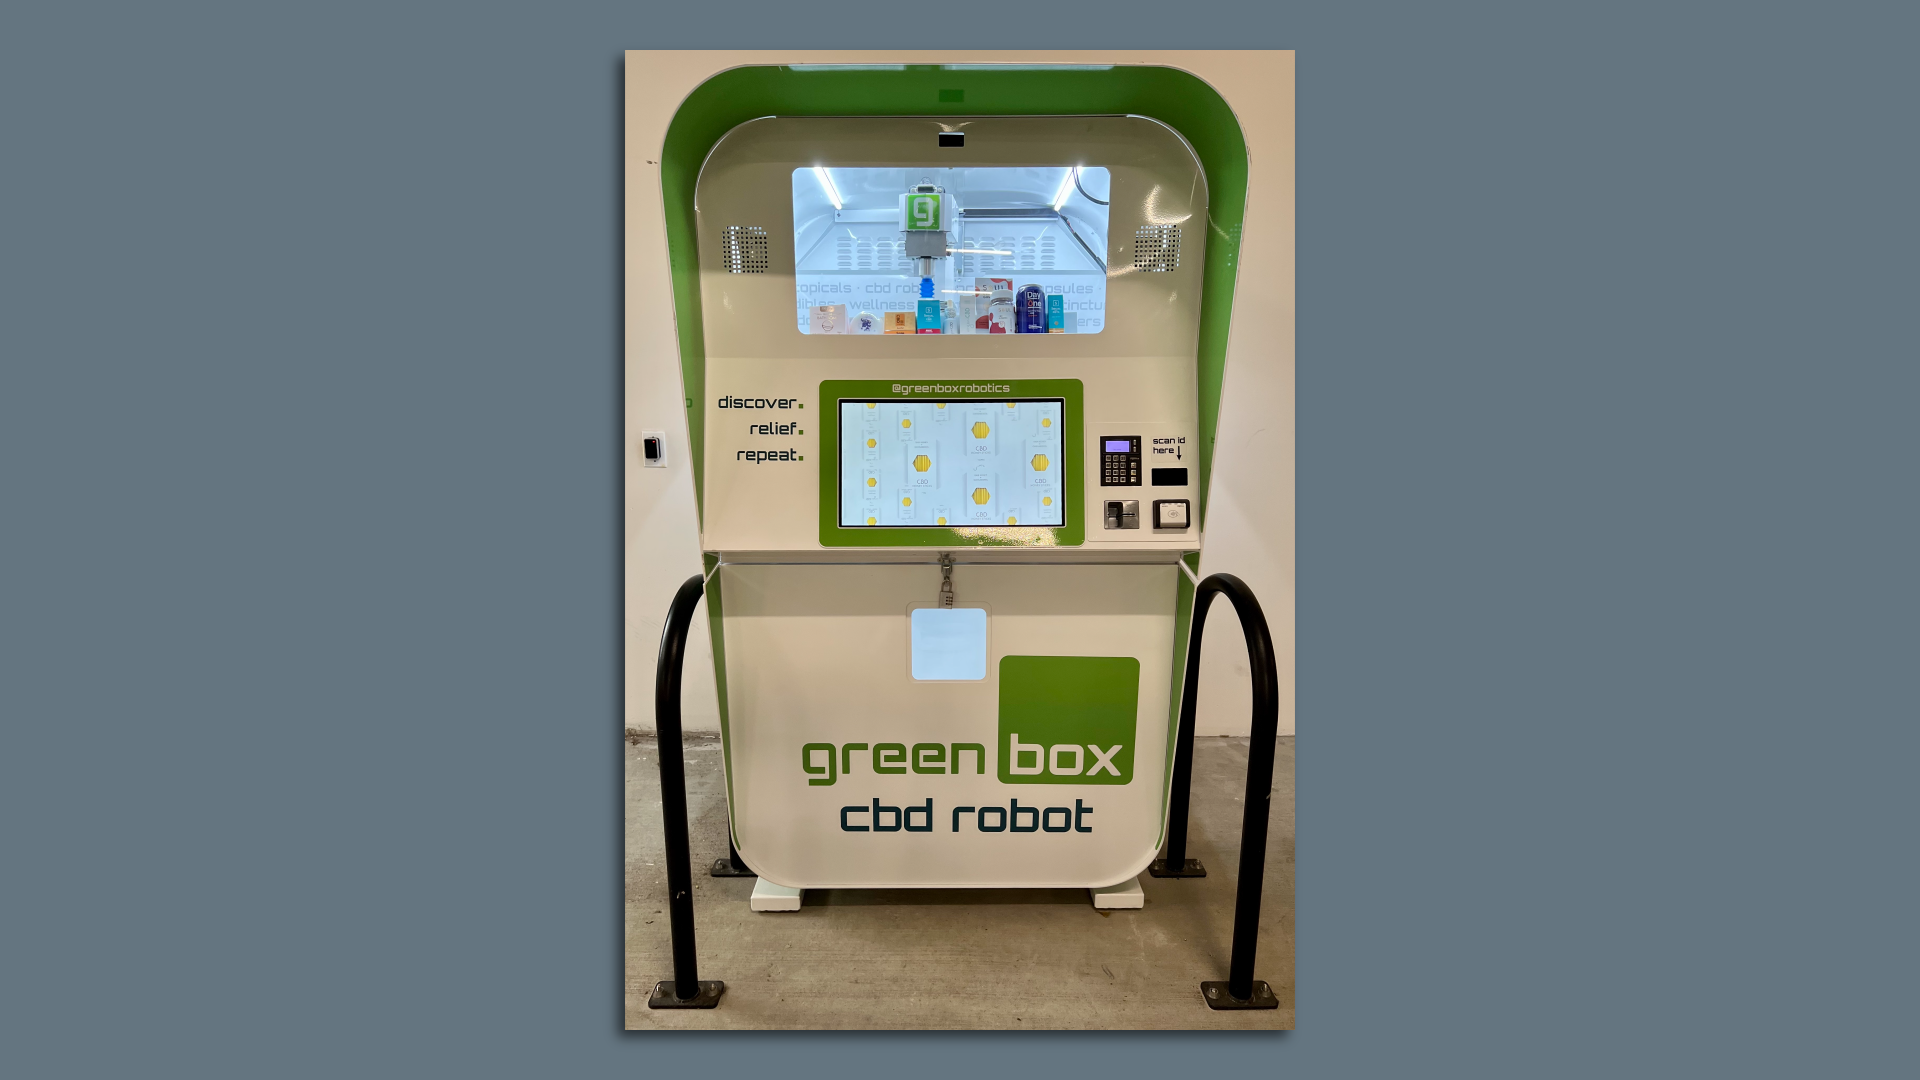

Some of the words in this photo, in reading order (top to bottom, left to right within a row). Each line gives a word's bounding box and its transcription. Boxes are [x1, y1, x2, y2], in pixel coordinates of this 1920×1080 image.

[865, 282, 892, 294] cbd
[895, 282, 920, 294] rob
[1042, 282, 1094, 295] psules
[1027, 291, 1040, 299] Day
[797, 298, 836, 310] dibles
[849, 298, 915, 310] wellness
[1063, 299, 1105, 310] inctu
[892, 383, 1011, 395] @greenboxrobotics
[717, 395, 804, 410] discover.
[749, 421, 804, 435] relief.
[1152, 437, 1175, 445] scan
[1177, 436, 1186, 444] id
[736, 448, 804, 464] repeat.
[1152, 446, 1175, 454] here
[802, 742, 986, 787] green
[1009, 733, 1124, 777] box
[840, 797, 933, 832] cbd
[952, 798, 1094, 833] robot
